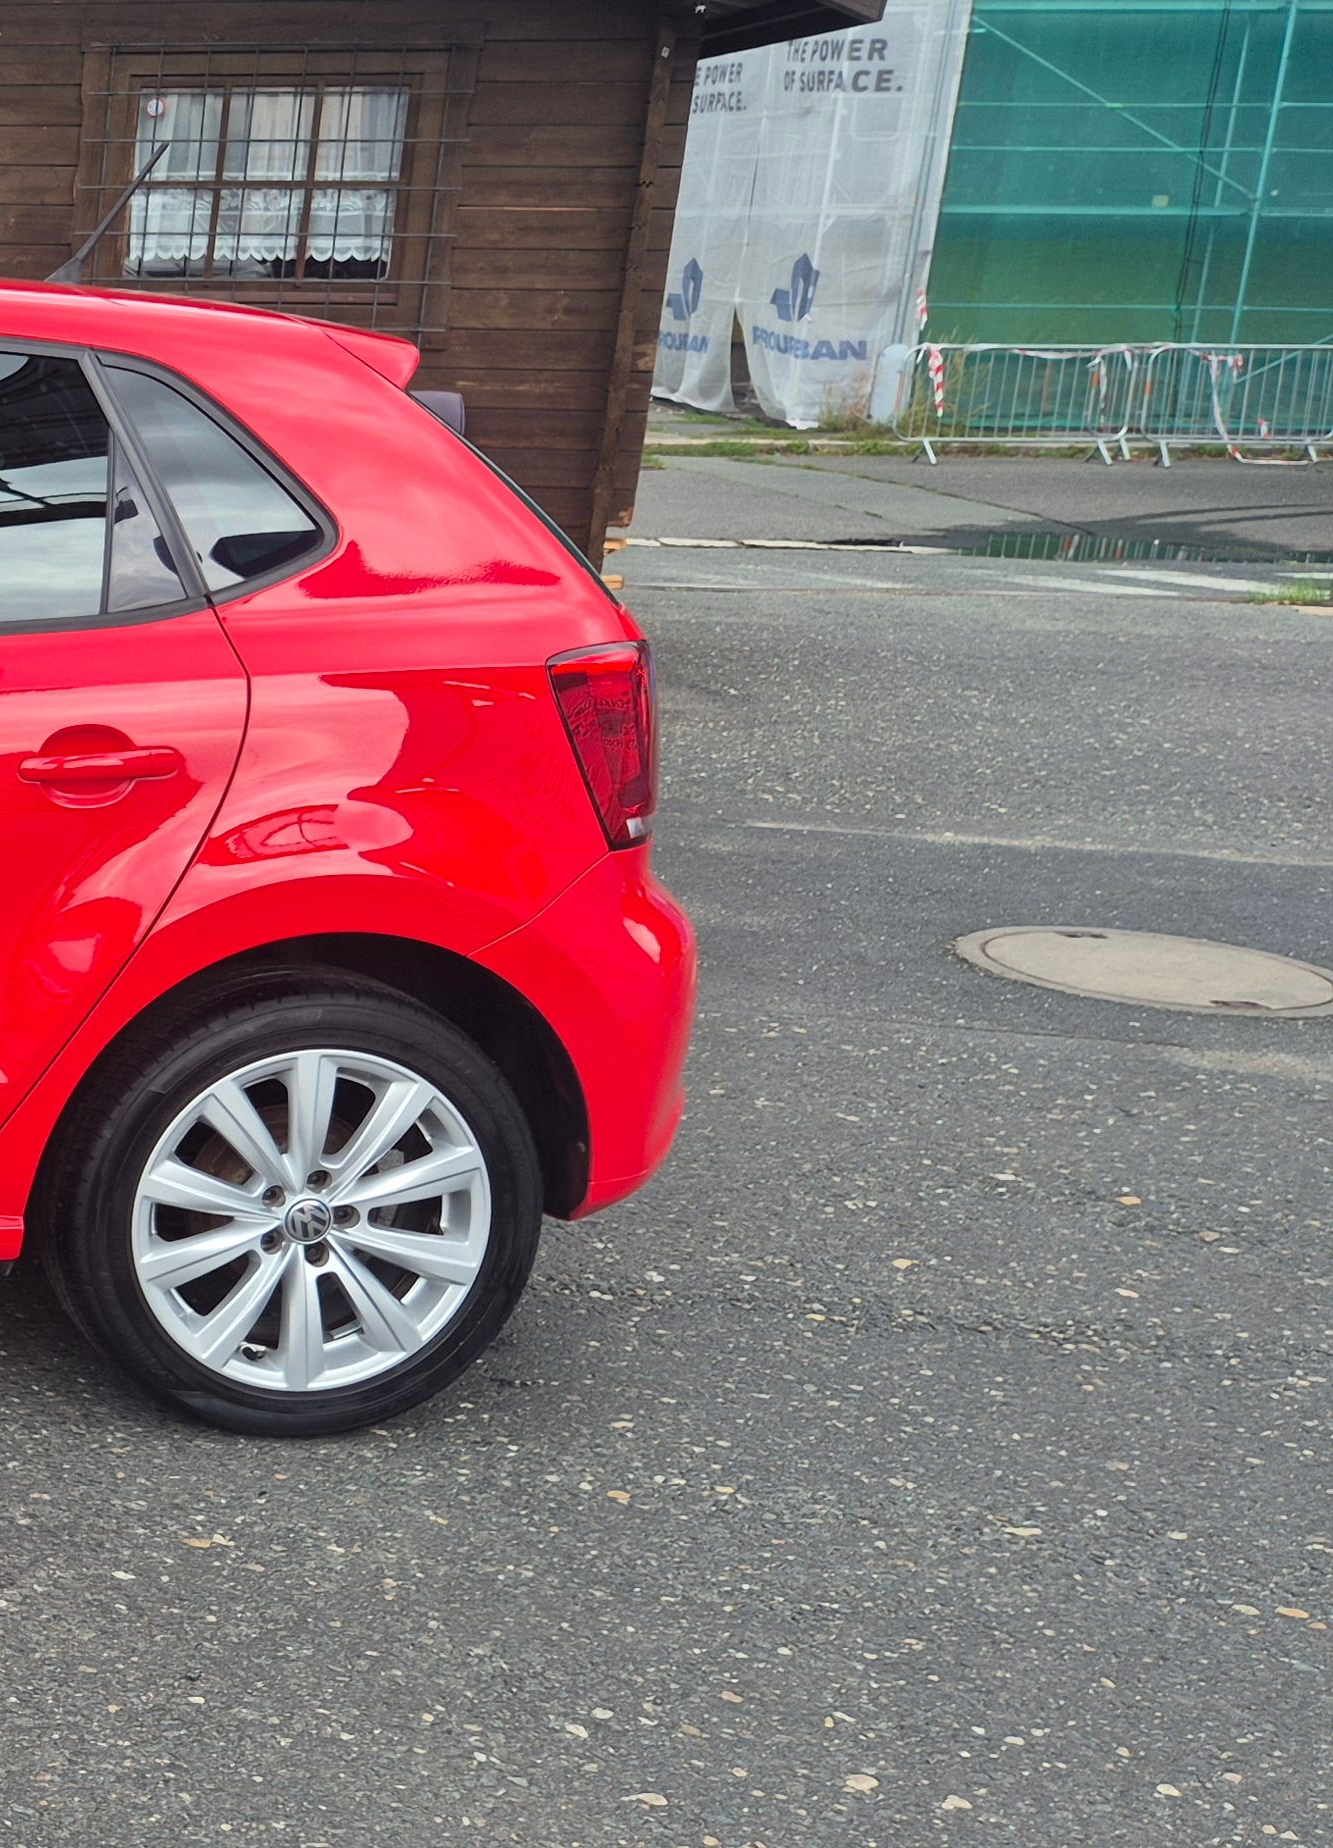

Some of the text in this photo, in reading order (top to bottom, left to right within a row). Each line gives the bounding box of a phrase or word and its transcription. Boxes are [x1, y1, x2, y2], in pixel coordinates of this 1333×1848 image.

[787, 38, 888, 64] THE POWER
[704, 61, 744, 86] POWER
[784, 68, 904, 93] OF SURFACE.
[692, 91, 747, 114] SURFACE.
